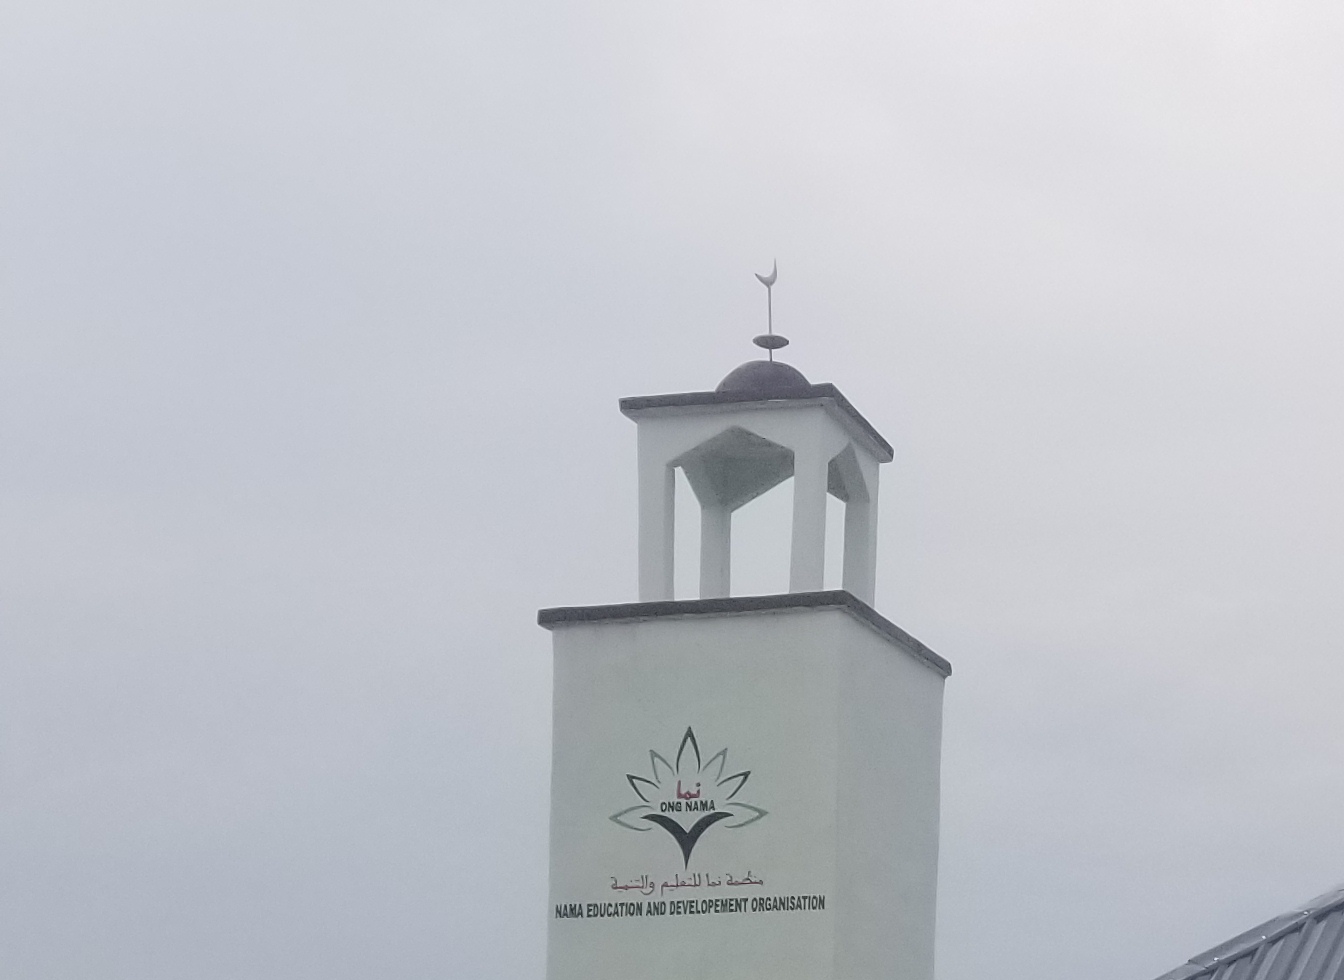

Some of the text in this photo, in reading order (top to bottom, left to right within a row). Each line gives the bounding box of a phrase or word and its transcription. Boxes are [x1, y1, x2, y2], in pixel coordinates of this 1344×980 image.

[676, 779, 701, 800] نما
[660, 800, 716, 813] ONG NAMA
[660, 873, 701, 897] للتعليم
[705, 873, 722, 888] نما
[725, 870, 764, 886] منظمة
[554, 894, 826, 919] NAMA EDUCATION AND DEVELOPEMENT ORGANISATION
